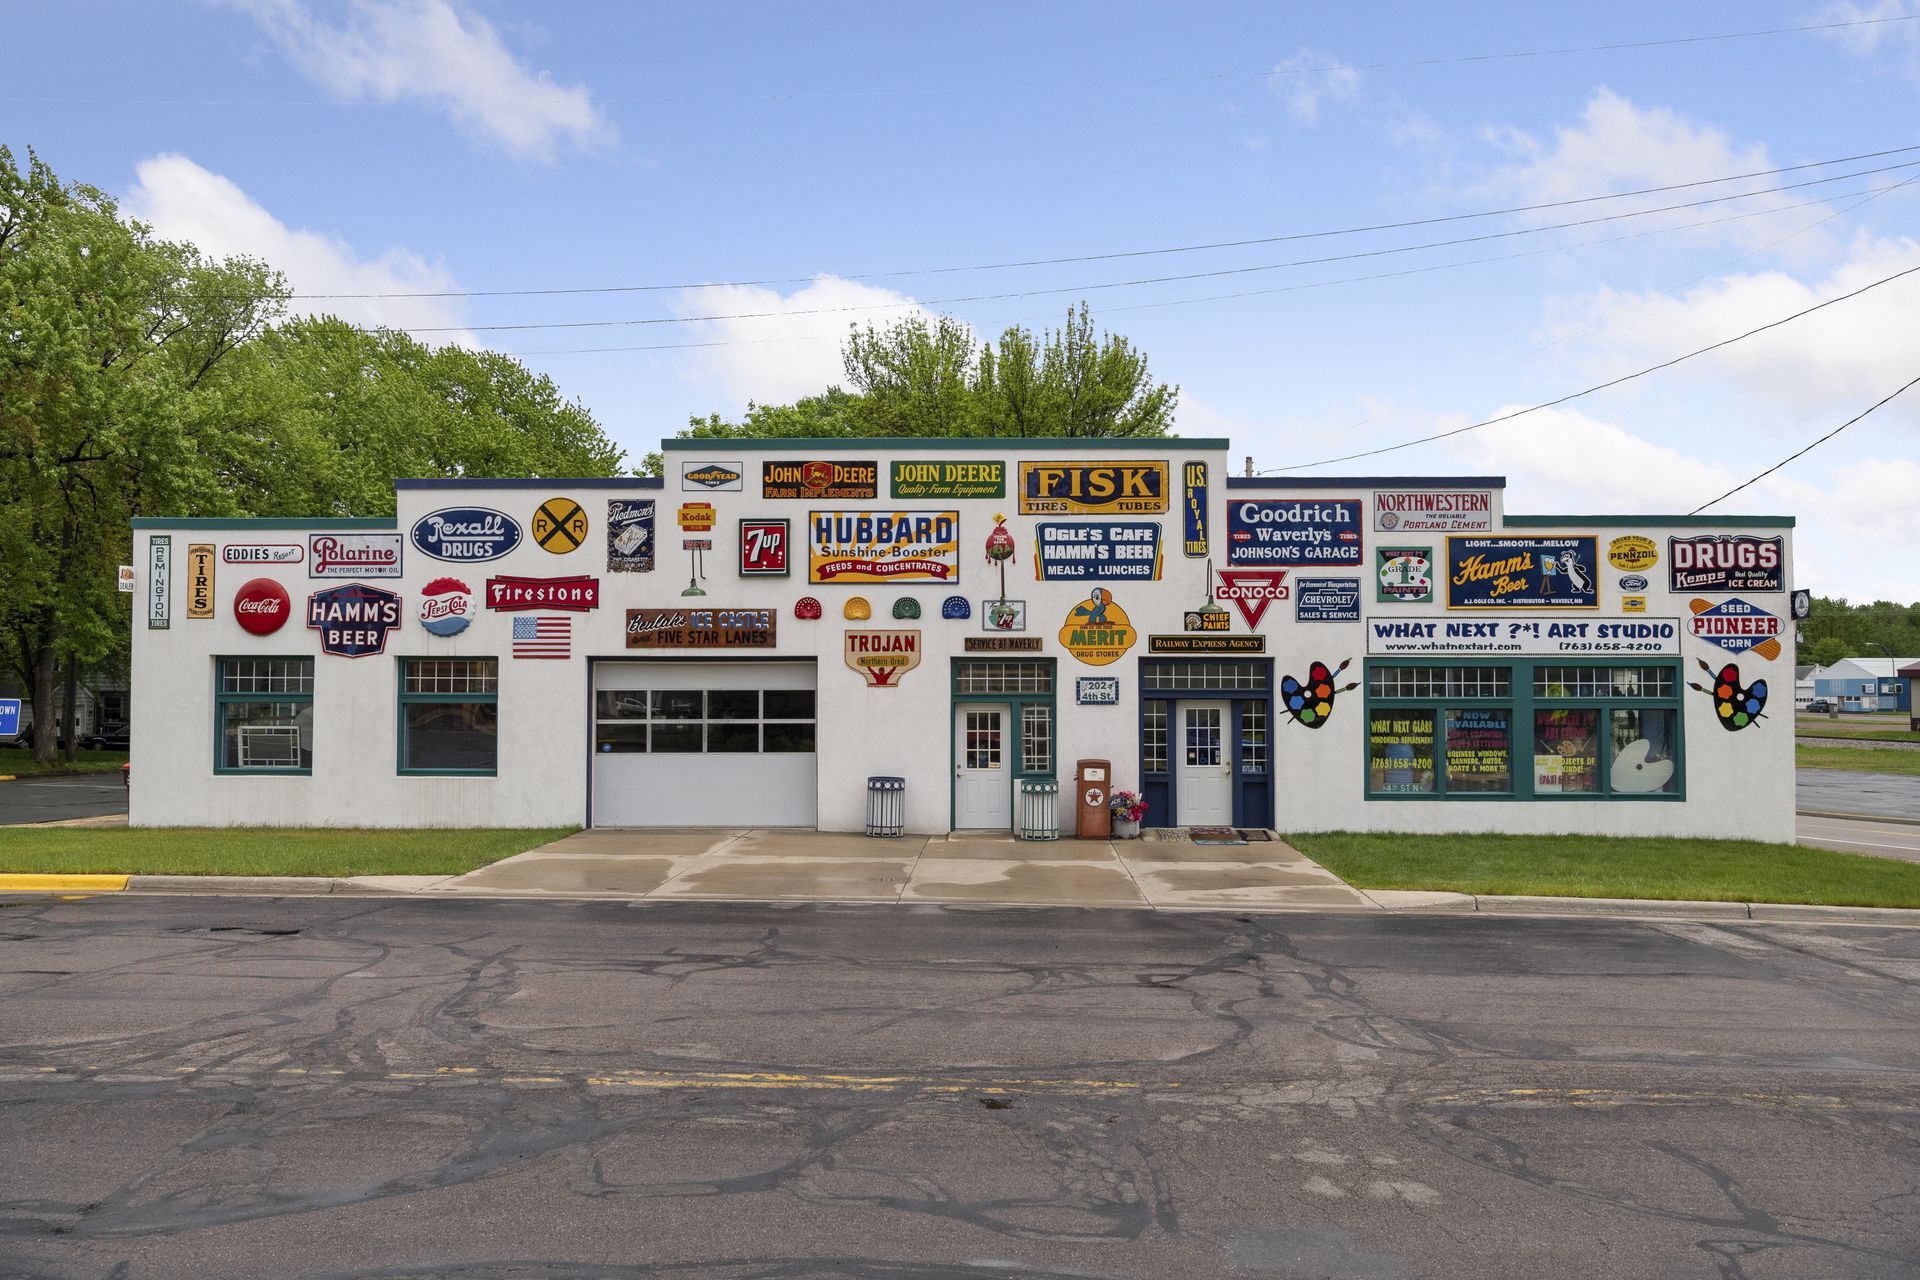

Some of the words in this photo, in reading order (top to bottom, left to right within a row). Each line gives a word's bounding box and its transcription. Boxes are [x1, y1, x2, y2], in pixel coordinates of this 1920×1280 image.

[765, 464, 803, 483] JOHN
[834, 464, 875, 483] DEERE
[895, 464, 940, 482] JOHN
[945, 464, 1000, 482] DEERE
[1186, 466, 1206, 488] U.S.
[1037, 469, 1153, 497] FISK
[765, 487, 796, 497] FARM
[800, 487, 874, 498] IMPLEMENTS
[898, 484, 929, 496] Quality
[931, 485, 951, 494] Farm
[952, 485, 997, 496] Equipment
[1026, 502, 1067, 511] TIRES
[1117, 502, 1161, 511] TUBES
[1377, 494, 1489, 512] NORTHWESTERN
[609, 502, 655, 524] Piedmont
[682, 512, 712, 521] Kodak
[1240, 503, 1350, 524] Goodrich
[427, 515, 503, 543] Rexall
[537, 521, 547, 532] R
[573, 521, 583, 532] R
[816, 517, 952, 544] HUBBARD
[1403, 520, 1447, 529] PORTLAND
[1451, 520, 1487, 529] CEMENT
[1044, 527, 1102, 541] OGLE'S
[1110, 528, 1153, 541] CAFE
[1256, 528, 1331, 544] Waverly's
[226, 547, 269, 560] EDDIE'S
[273, 549, 296, 561] Resort
[441, 542, 493, 557] DRUGS
[1044, 544, 1109, 559] HAMM'S
[1115, 545, 1154, 559] BEER
[1186, 542, 1207, 554] TIRES
[1232, 547, 1300, 558] JOHNSON'S
[1305, 547, 1358, 558] GARAGE
[313, 537, 398, 574] Polarine
[1610, 550, 1657, 560] PENNZOIL
[1674, 543, 1778, 568] DRUGS
[825, 562, 852, 572] FEEDS
[856, 563, 872, 571] and
[876, 562, 942, 573] CONCENTRATES
[1047, 566, 1084, 575] MEALS
[1098, 566, 1150, 575] LUNCHES
[1453, 552, 1534, 585] Hamm's
[120, 582, 134, 590] DEALER
[155, 547, 166, 619] REMINGTON
[194, 555, 208, 609] TIRES
[1676, 571, 1726, 588] Kemps
[1747, 571, 1768, 579] Quality
[1728, 579, 1744, 588] ICE
[1747, 579, 1777, 588] CREAM
[491, 584, 594, 602] Firestone
[1218, 587, 1287, 598] CONOCO
[1490, 577, 1528, 597] Beer
[1305, 595, 1352, 604] CHEVROLET
[311, 601, 397, 623] HAMM'S
[1720, 605, 1750, 613] SEED
[691, 611, 713, 629] ICE
[719, 611, 769, 629] CASTLE
[1203, 613, 1229, 621] CHIEF
[1203, 621, 1229, 630] PAINTS
[1374, 623, 1437, 638] WHAT
[1445, 623, 1499, 638] NEXT
[1548, 623, 1590, 638] ART
[1597, 623, 1674, 639] STUDIO
[1693, 617, 1778, 635] PIONEER
[328, 631, 377, 646] BEER
[657, 631, 683, 644] FIVE
[687, 631, 719, 644] STAR
[726, 631, 767, 644] LANES
[848, 634, 915, 652] TROJAN
[1069, 629, 1127, 646] MERIT
[1155, 640, 1189, 648] RAILWAY
[1192, 640, 1227, 648] EXPRESS
[1229, 640, 1260, 648] AGENCY
[1721, 639, 1751, 648] CORN
[968, 639, 997, 650] SERVICE
[1385, 642, 1521, 651] www.whatnextart.com
[1559, 642, 1592, 651] (763)
[1595, 642, 1662, 651] 658-4200
[1088, 681, 1106, 690] 202
[1082, 692, 1098, 701] 4th
[1100, 692, 1114, 701] St.
[1463, 712, 1490, 720] NOW
[1371, 720, 1391, 733] WHAT
[1393, 720, 1411, 733] NEXT
[1412, 720, 1433, 733] GLASS
[1372, 756, 1392, 769] (763)
[1393, 757, 1432, 769] 658-4200
